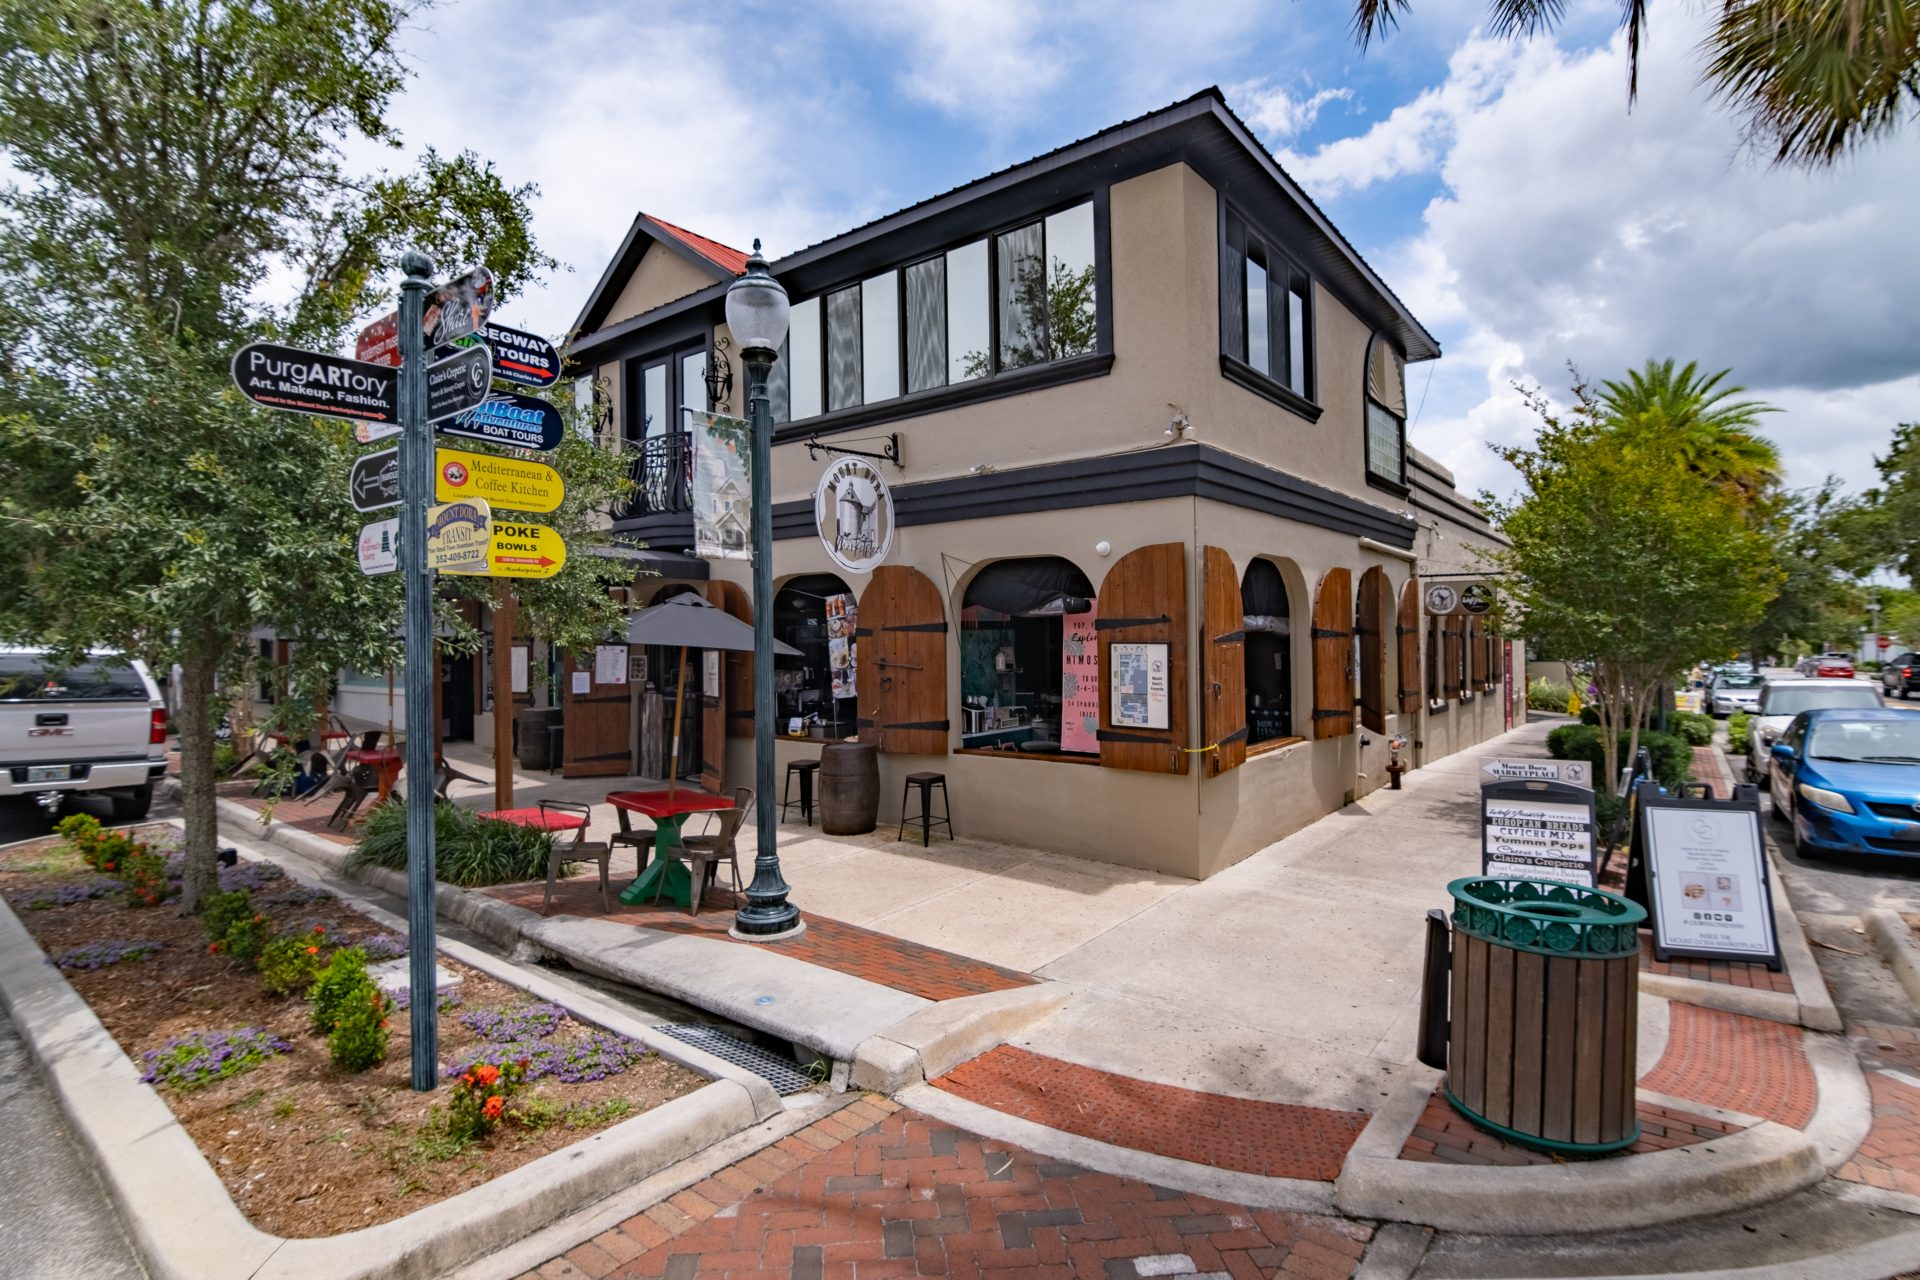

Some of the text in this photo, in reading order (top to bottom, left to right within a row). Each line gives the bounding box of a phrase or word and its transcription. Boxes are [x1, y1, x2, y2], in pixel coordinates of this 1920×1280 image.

[477, 326, 549, 353] SEGWAY
[498, 346, 549, 368] TOURS
[250, 351, 387, 397] PurgARTory
[250, 377, 390, 408] Art. Makeup. Fashion.
[473, 413, 543, 433] Adventures
[483, 425, 544, 443] BOAT TOURS
[471, 460, 553, 482] Mediterranean &
[475, 477, 549, 497] Coffee Kitchen
[828, 462, 885, 500] MOUNT DORA
[443, 527, 472, 544] TRANSIT
[493, 525, 540, 538] POKE
[497, 542, 537, 551] BOWLS
[435, 550, 479, 564] 352-409-8722
[28, 726, 74, 736] GMC
[1493, 769, 1556, 778] MARKETPLACE
[1492, 818, 1585, 832] EUROPEAN BREADS
[1500, 827, 1576, 840] CEVICHE MIX
[1493, 835, 1585, 850] Yummm Pops
[1493, 854, 1585, 869] Claire's Creperie
